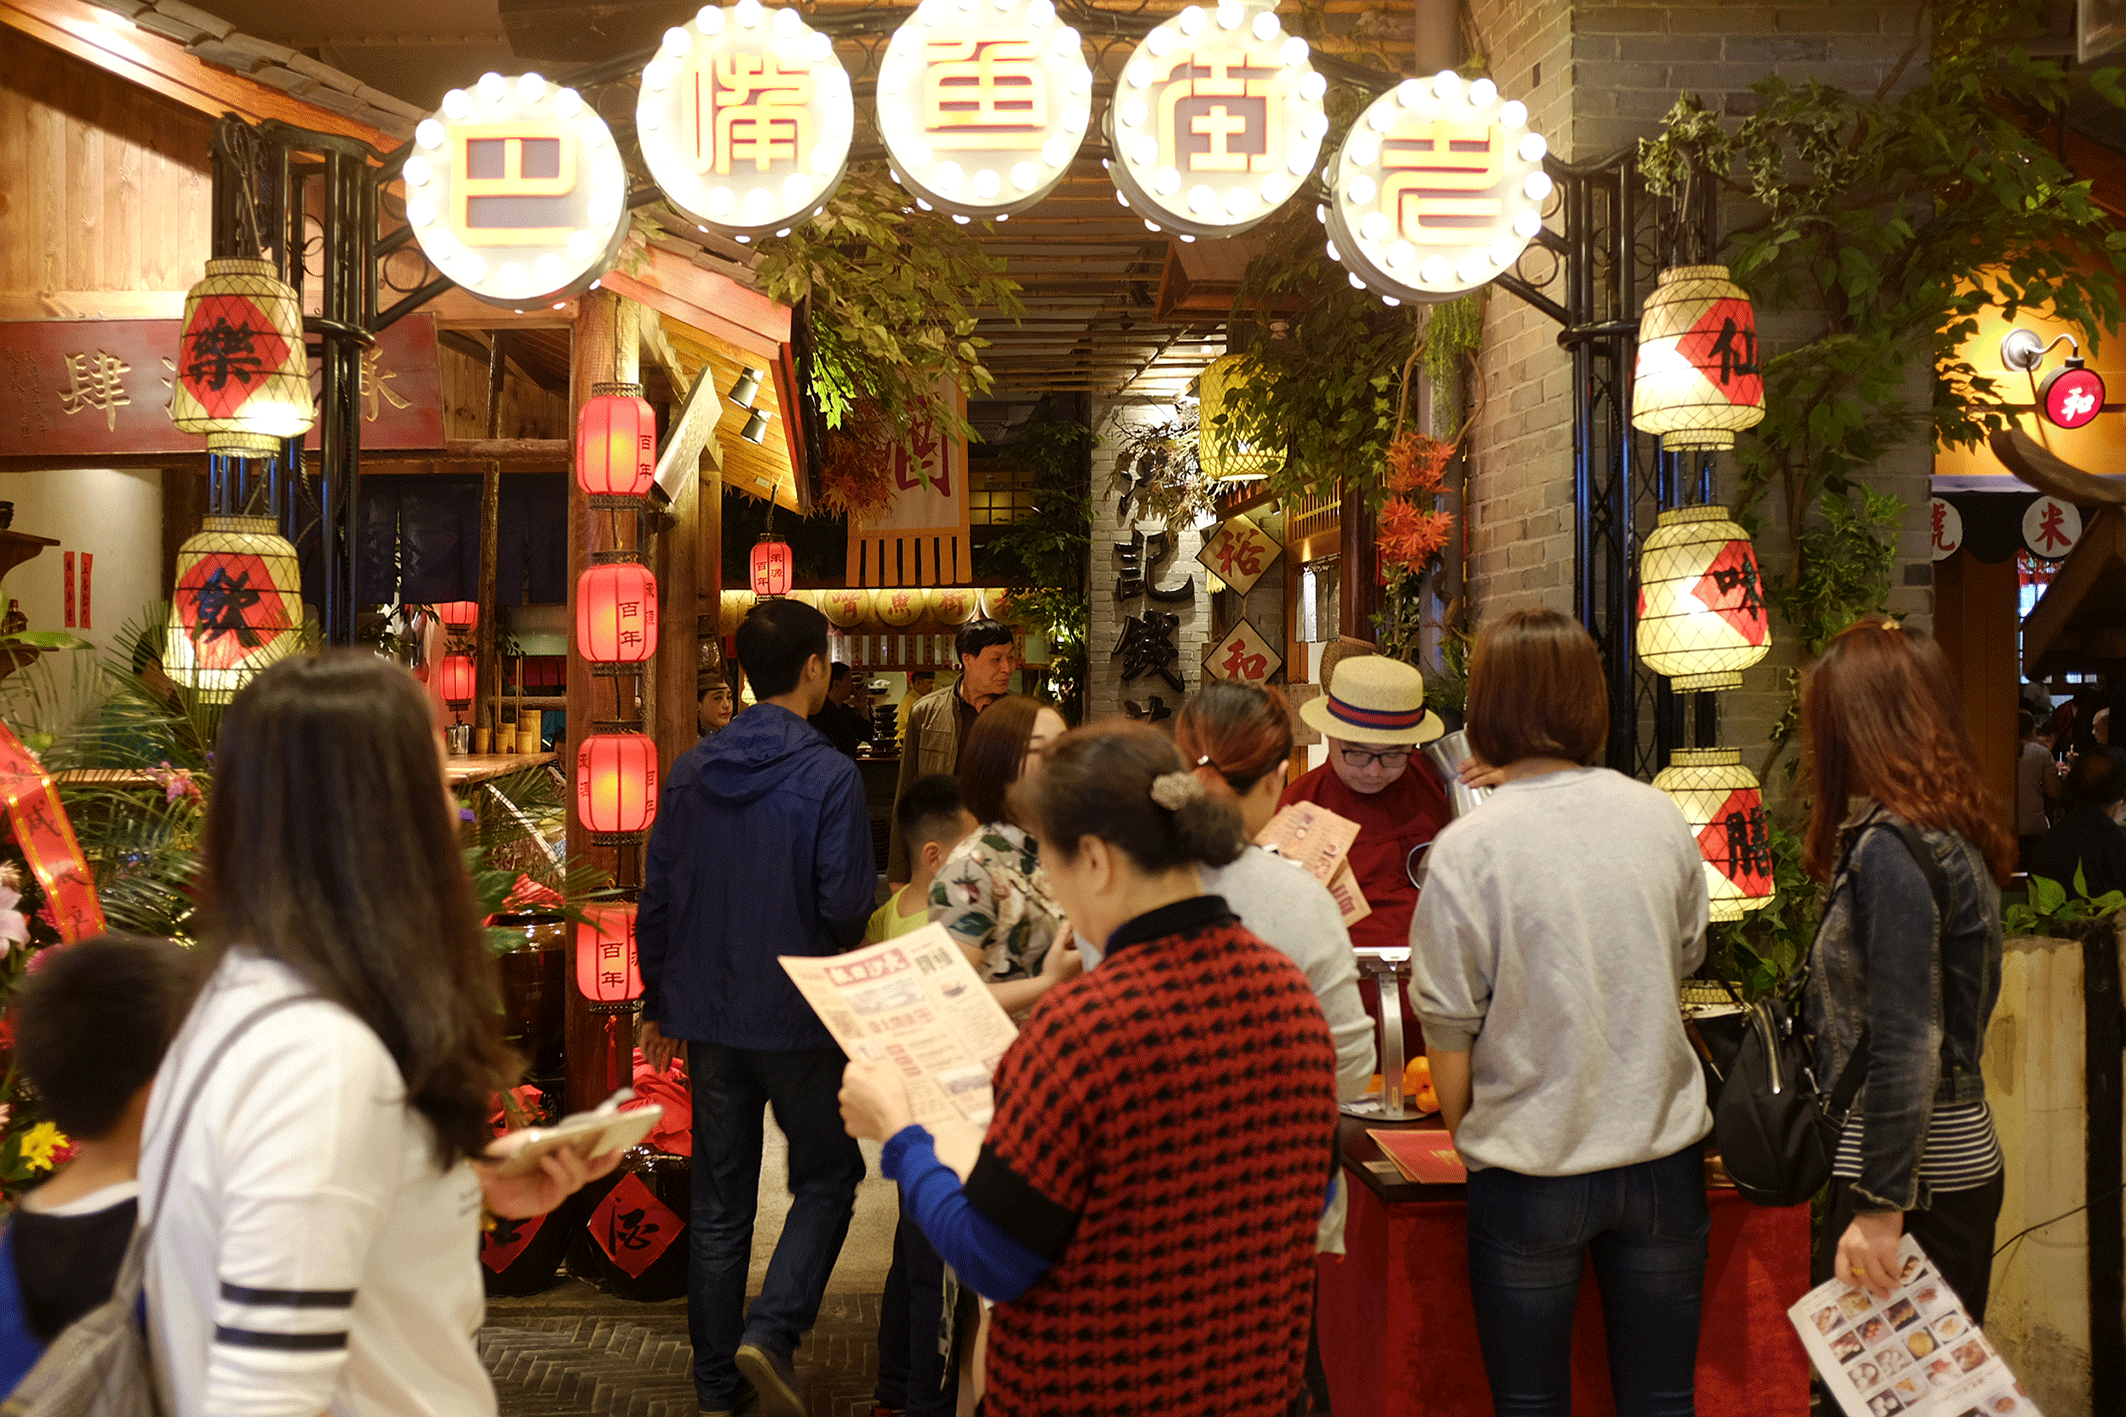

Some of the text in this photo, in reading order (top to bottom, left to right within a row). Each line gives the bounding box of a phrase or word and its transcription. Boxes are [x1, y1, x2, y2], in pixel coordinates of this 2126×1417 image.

[188, 316, 262, 392] 樂
[1708, 316, 1762, 385] 仙
[2060, 386, 2096, 422] 和
[639, 434, 653, 480] 百年
[2034, 501, 2073, 552] 米
[755, 560, 769, 587] 百年
[618, 601, 643, 648] 百年
[1221, 638, 1269, 681] 和
[599, 942, 625, 989] 百年
